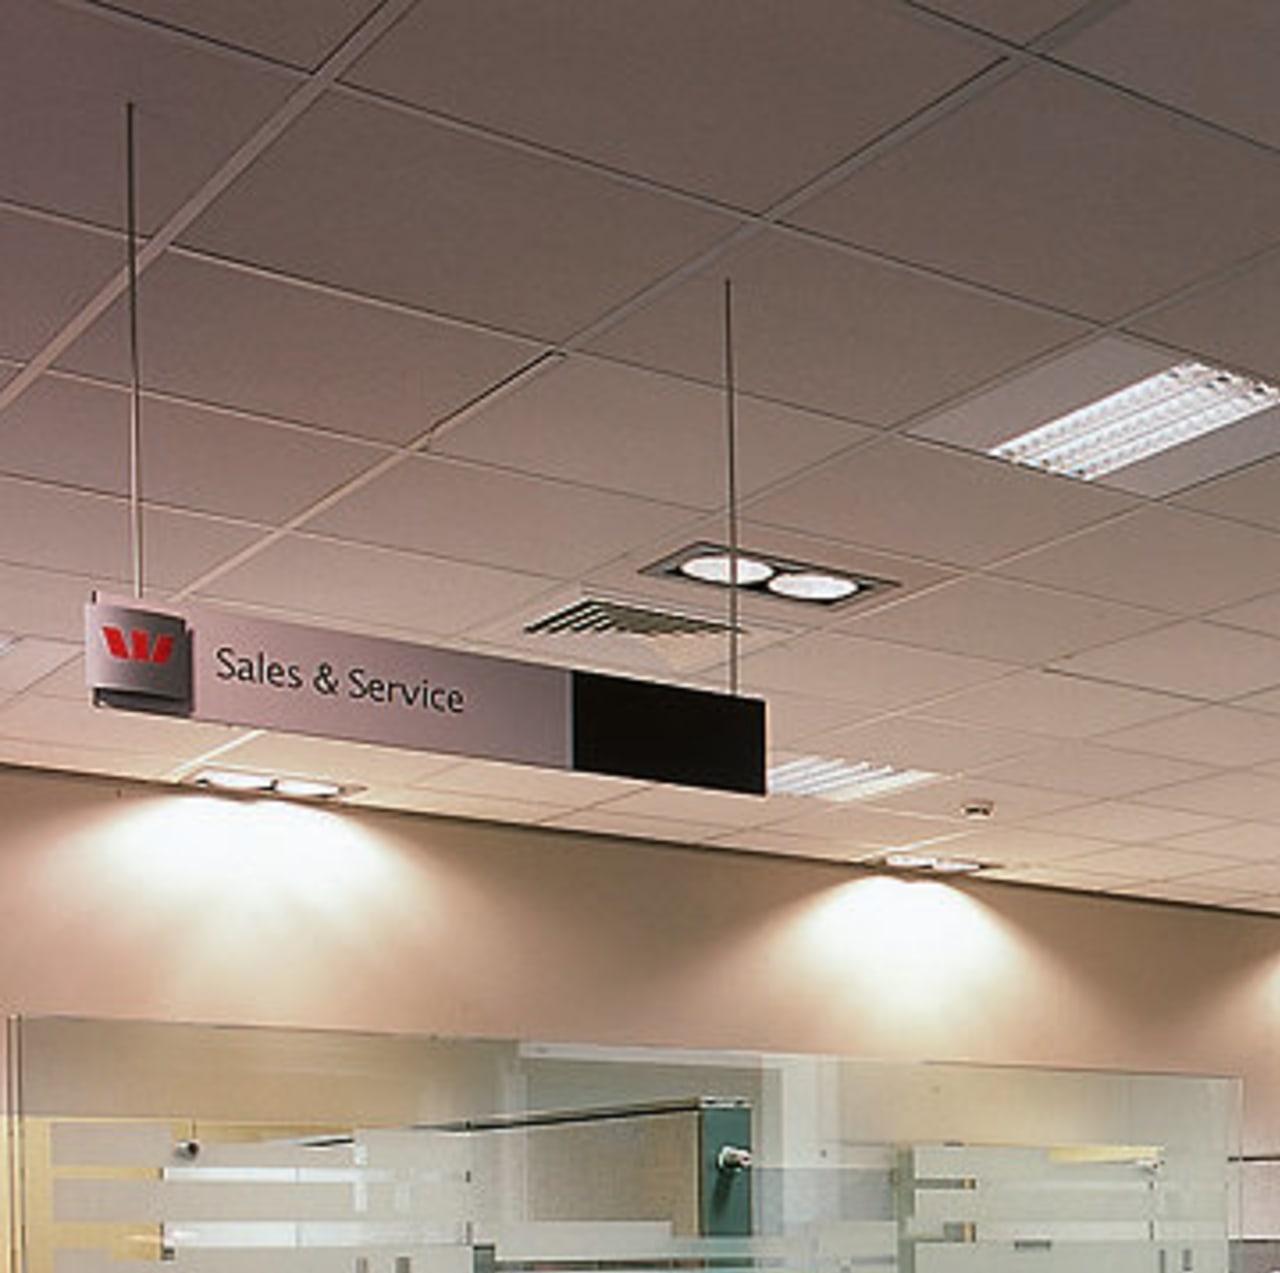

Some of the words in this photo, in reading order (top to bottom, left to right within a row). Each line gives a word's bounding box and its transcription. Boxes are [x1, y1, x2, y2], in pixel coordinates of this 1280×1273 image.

[216, 647, 303, 689] Sales
[313, 661, 340, 696] &
[348, 668, 466, 714] Service
